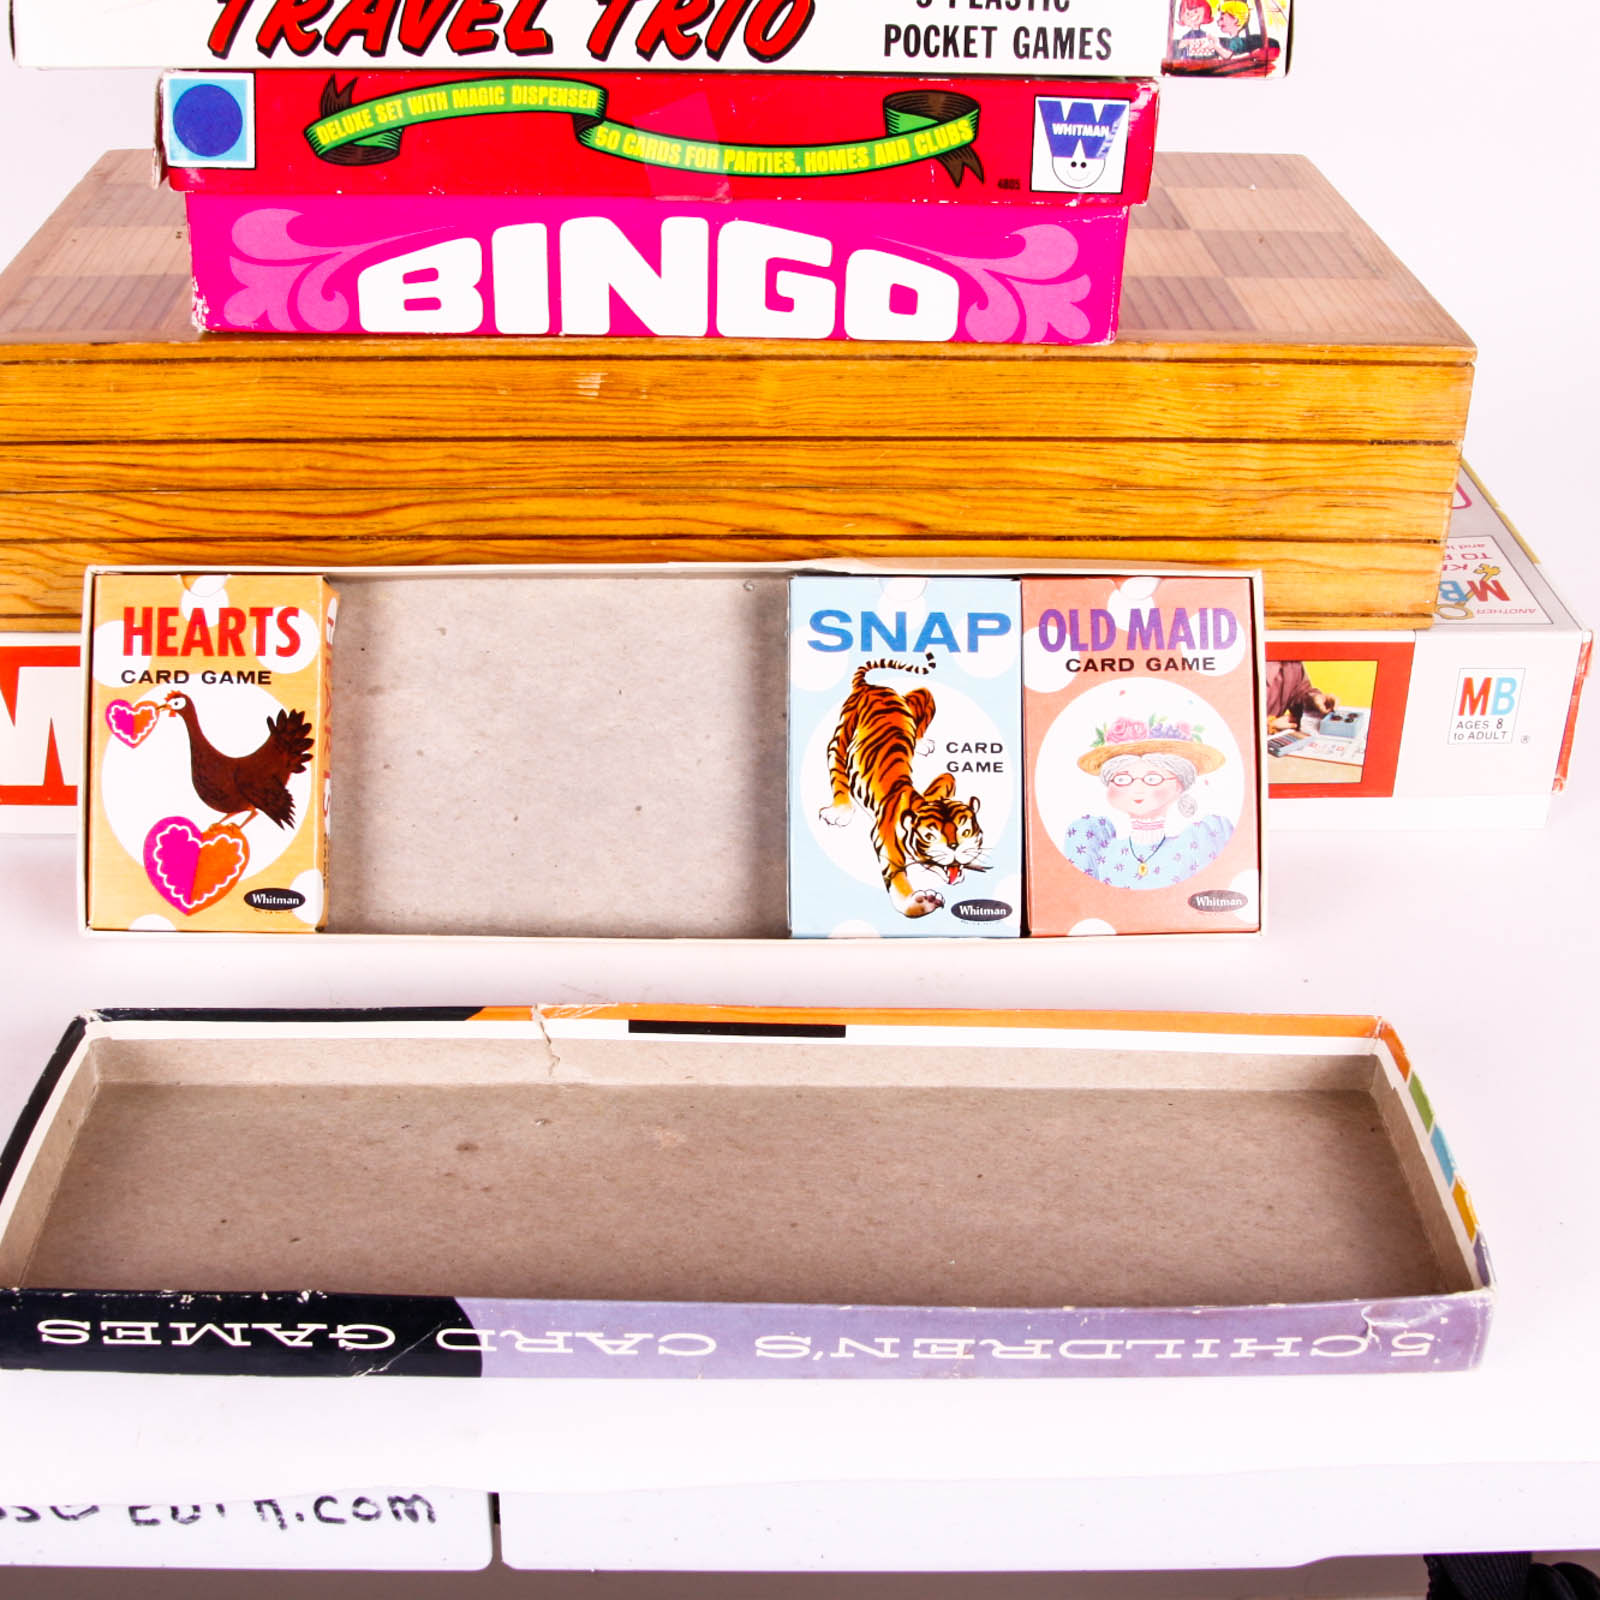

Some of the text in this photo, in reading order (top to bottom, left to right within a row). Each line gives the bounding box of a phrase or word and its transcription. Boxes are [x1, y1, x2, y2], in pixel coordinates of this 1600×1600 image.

[207, 0, 816, 63] TRAVEL TRIO
[884, 23, 1112, 60] POCKET GAMES
[314, 84, 599, 145] DELUXE SET WITH MAGIC DISPENSER
[1052, 123, 1111, 137] WHITMAN
[594, 119, 974, 175] 50 CARDS FOR PARTIES, HOMES AND CLUBS
[357, 216, 960, 341] BINGO
[1462, 552, 1493, 562] TO
[123, 607, 300, 657] HEARTS
[807, 609, 1012, 654] SNAP
[1038, 608, 1238, 653] OLD MAID
[1065, 657, 1216, 673] CARD GAME
[121, 670, 272, 685] CARD GAME
[1458, 677, 1517, 716] MB
[1457, 718, 1504, 731] AGES 8
[1453, 730, 1508, 742] to ADULT
[946, 741, 1003, 755] CARD
[946, 760, 1004, 775] GAME
[252, 893, 300, 905] Whitman
[1196, 895, 1242, 907] Whitman
[959, 905, 1007, 916] Whitman
[37, 1319, 1436, 1362] 5 CHILDREN'S CARD GAMES
